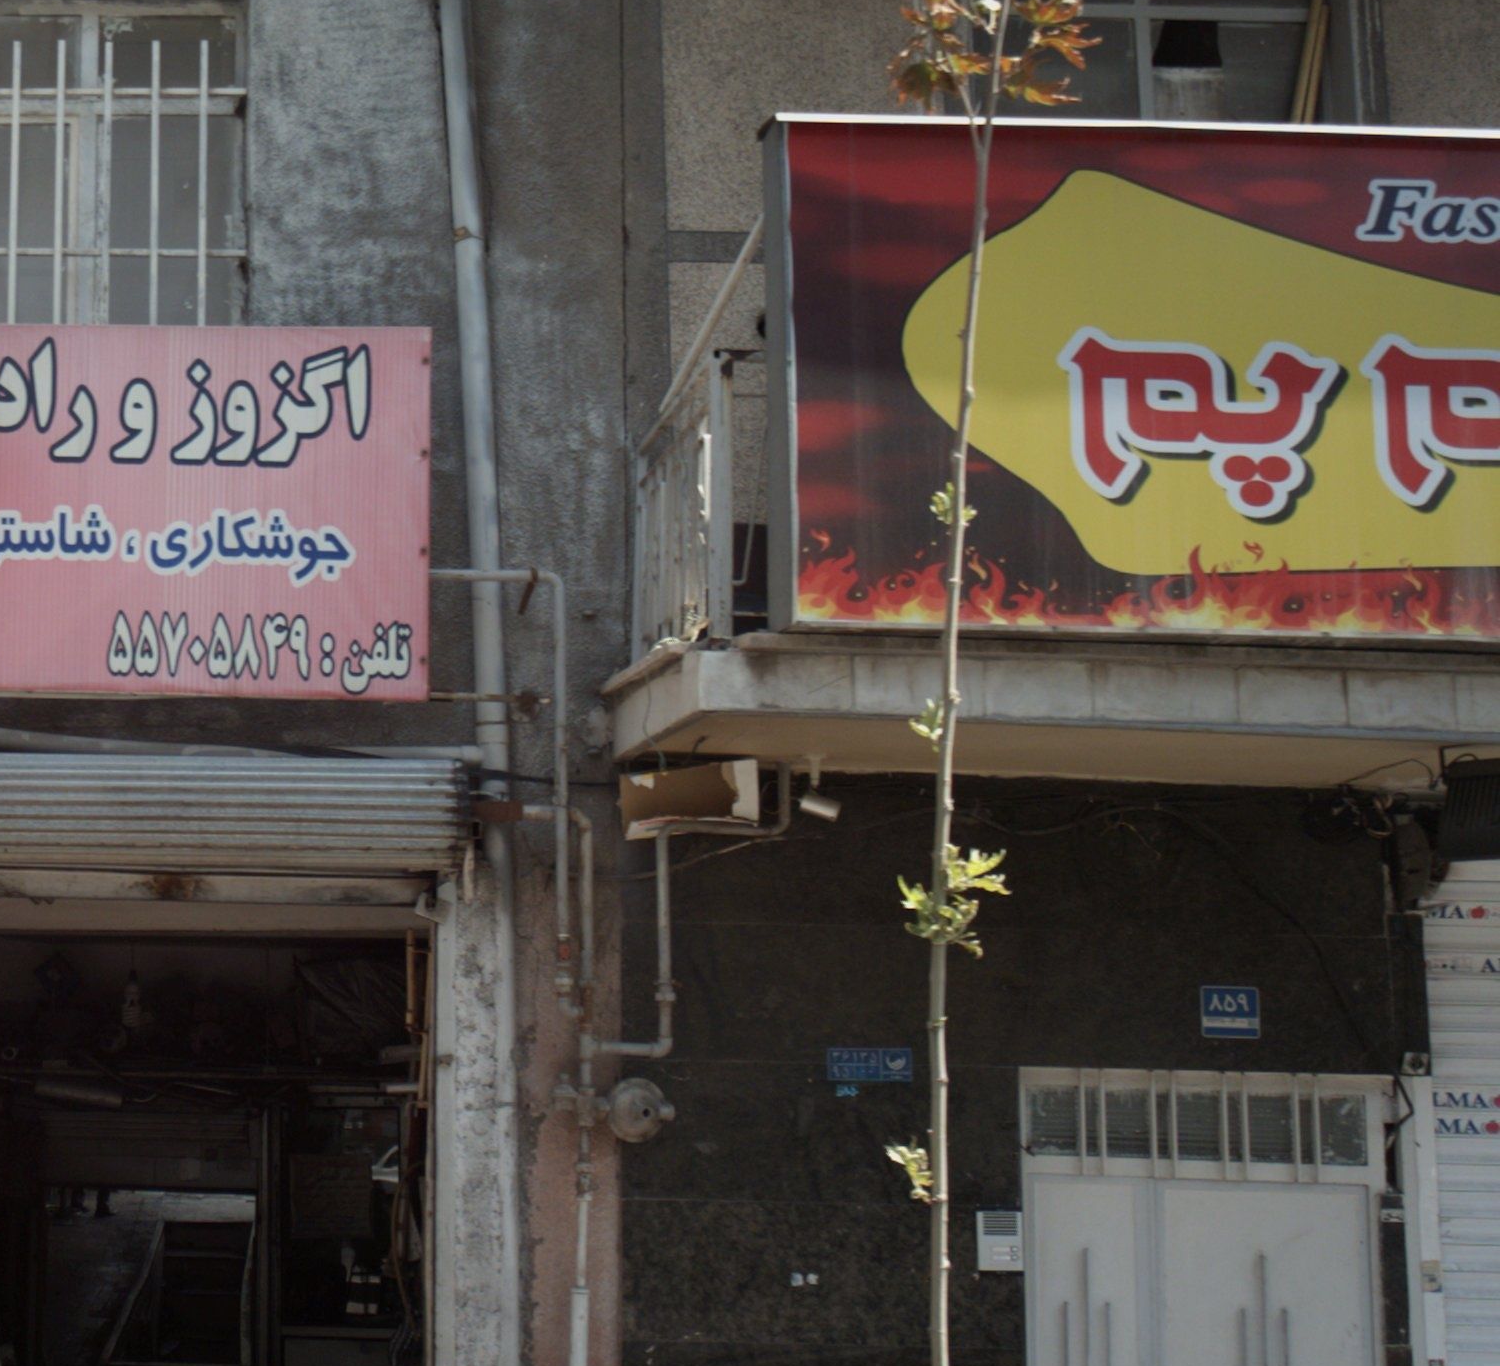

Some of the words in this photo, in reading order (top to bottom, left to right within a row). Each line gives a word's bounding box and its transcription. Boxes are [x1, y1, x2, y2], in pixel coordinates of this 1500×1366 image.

[109, 377, 158, 465] و
[170, 343, 371, 468] اگزوز
[106, 609, 311, 682] ۵۵۷۰۵۸۴۹
[1208, 992, 1251, 1013] ۸۵۹
